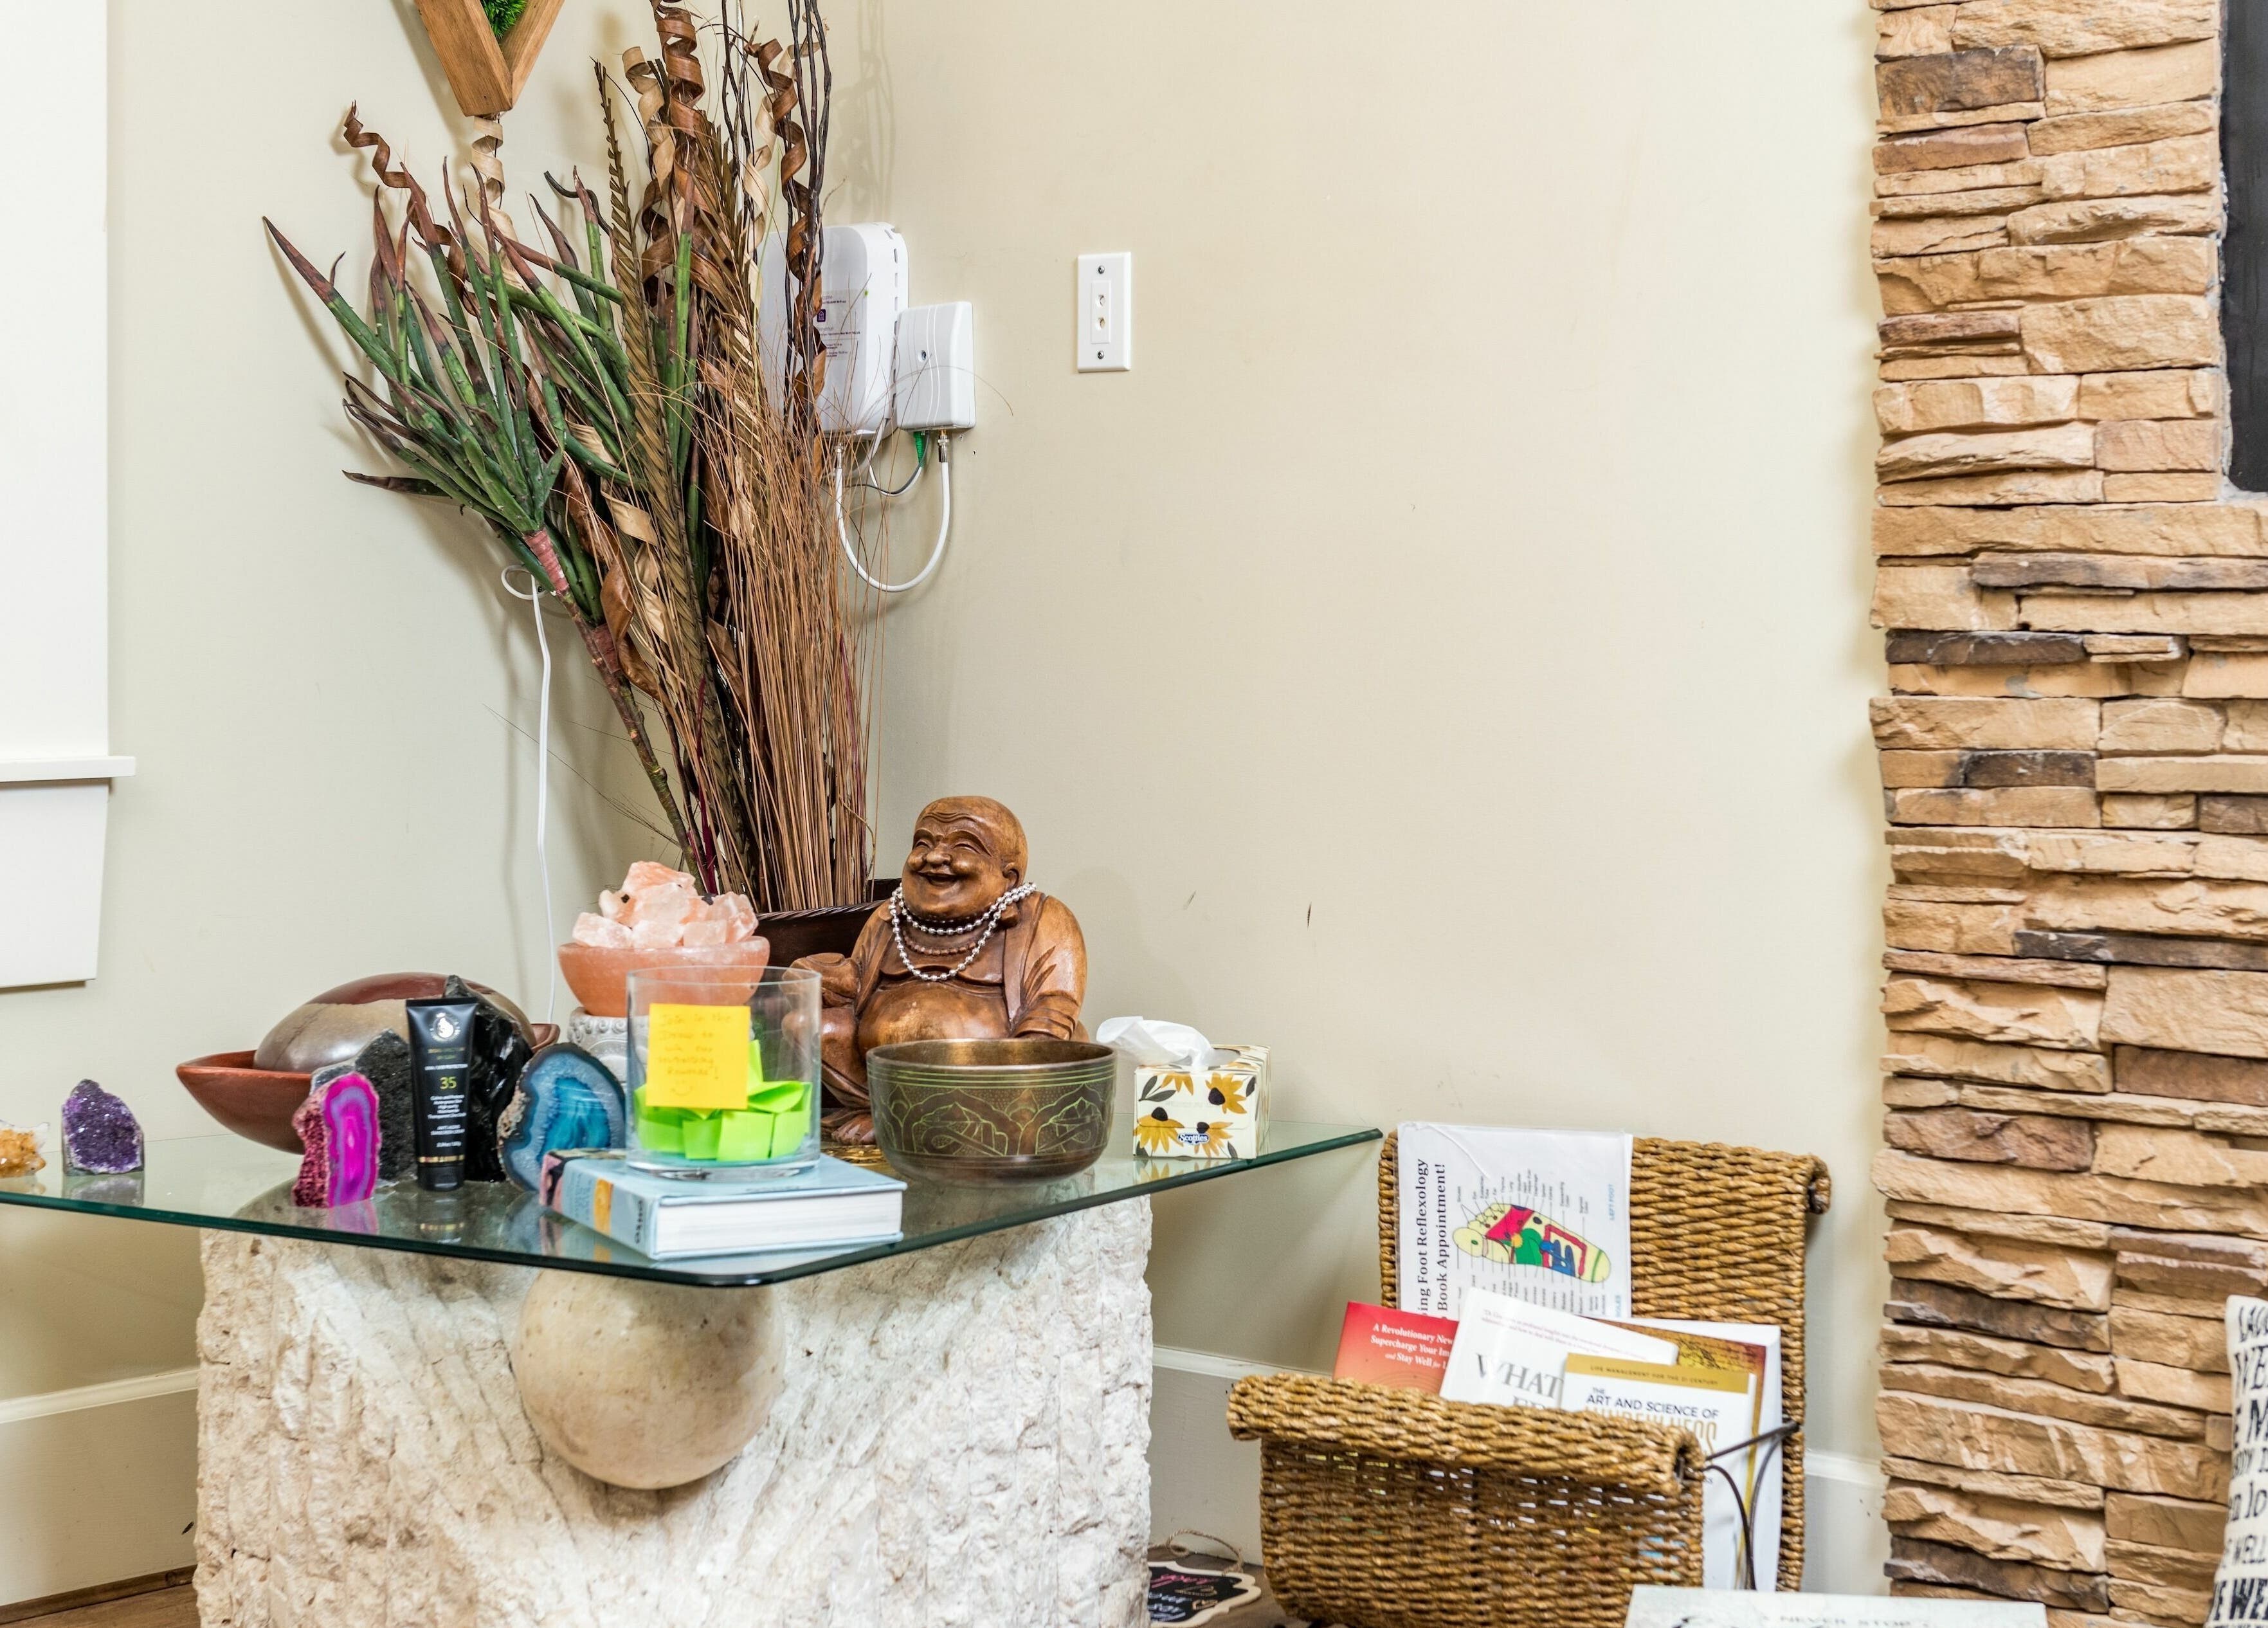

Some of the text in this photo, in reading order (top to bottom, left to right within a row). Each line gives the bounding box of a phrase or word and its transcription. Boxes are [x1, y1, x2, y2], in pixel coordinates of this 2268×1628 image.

[439, 1076, 457, 1090] 35
[1178, 1133, 1209, 1144] Scotties
[1415, 1158, 1431, 1315] ing Foot Reflexology
[1435, 1164, 1450, 1312] Book Appointment!
[1373, 1323, 1453, 1345] A Revolutionary New
[1370, 1335, 1417, 1352] Supercharge
[1419, 1343, 1437, 1355] Your
[1397, 1352, 1413, 1365] Stay
[1415, 1355, 1432, 1367] Well
[1476, 1353, 1565, 1400] WHAT
[1593, 1386, 1606, 1395] THE
[1586, 1394, 1719, 1420] ART AND SCIENCE OF
